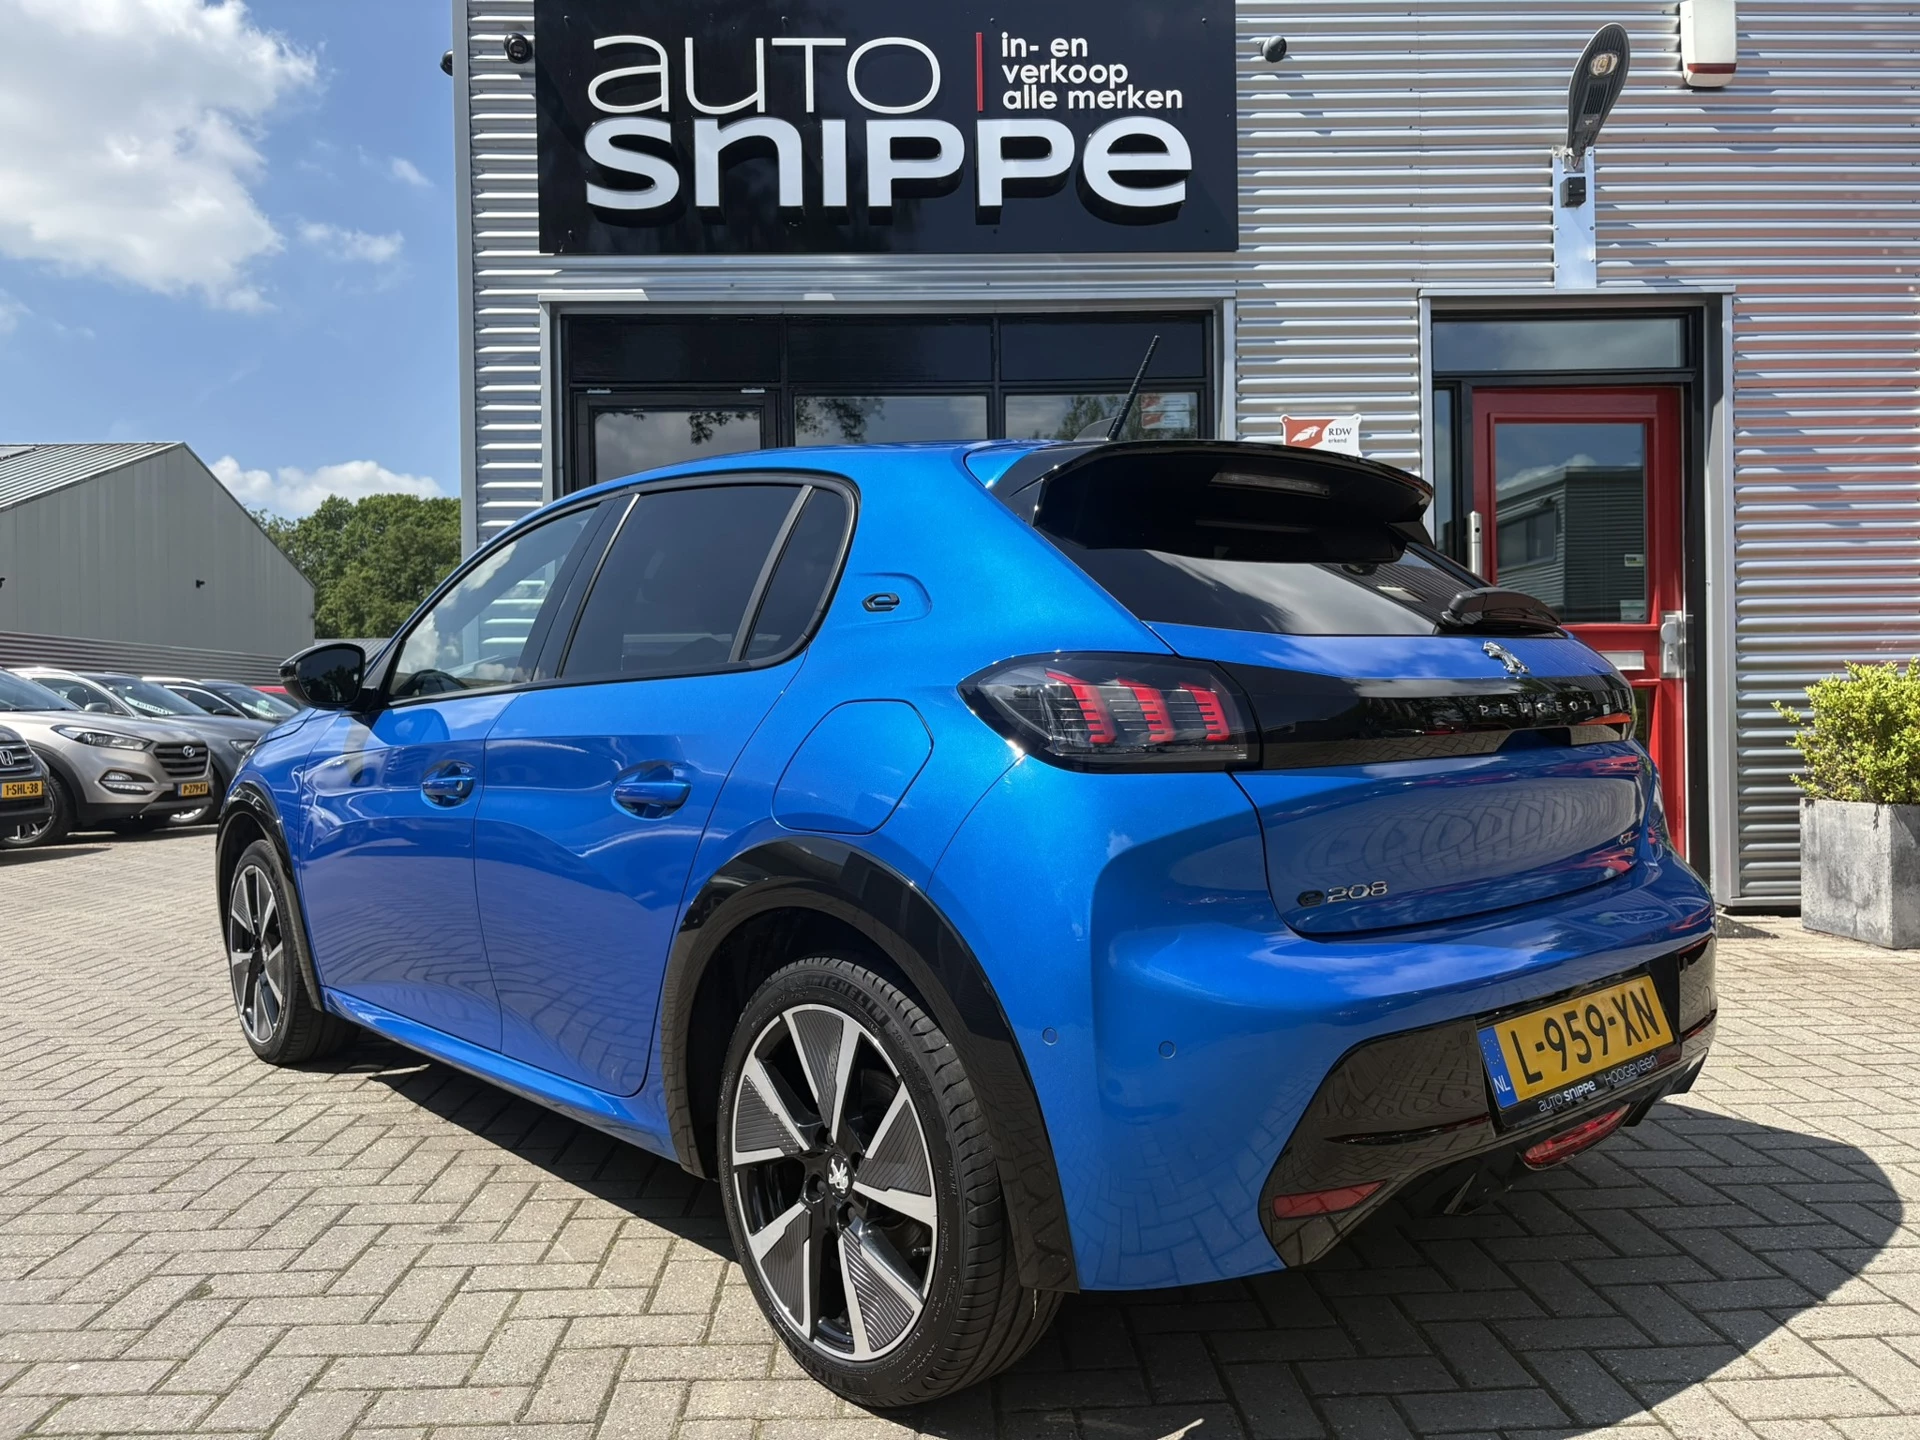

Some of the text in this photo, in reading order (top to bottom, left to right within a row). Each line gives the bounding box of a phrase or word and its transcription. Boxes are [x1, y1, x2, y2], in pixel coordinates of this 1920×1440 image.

[1001, 31, 1088, 57] in- en
[1001, 58, 1128, 89] verkoop
[1002, 84, 1183, 109] alle merken
[1328, 427, 1352, 436] RDW
[1479, 700, 1591, 716] PEUGEOT
[1511, 987, 1660, 1085] L-959-XN
[1493, 1074, 1511, 1095] NL
